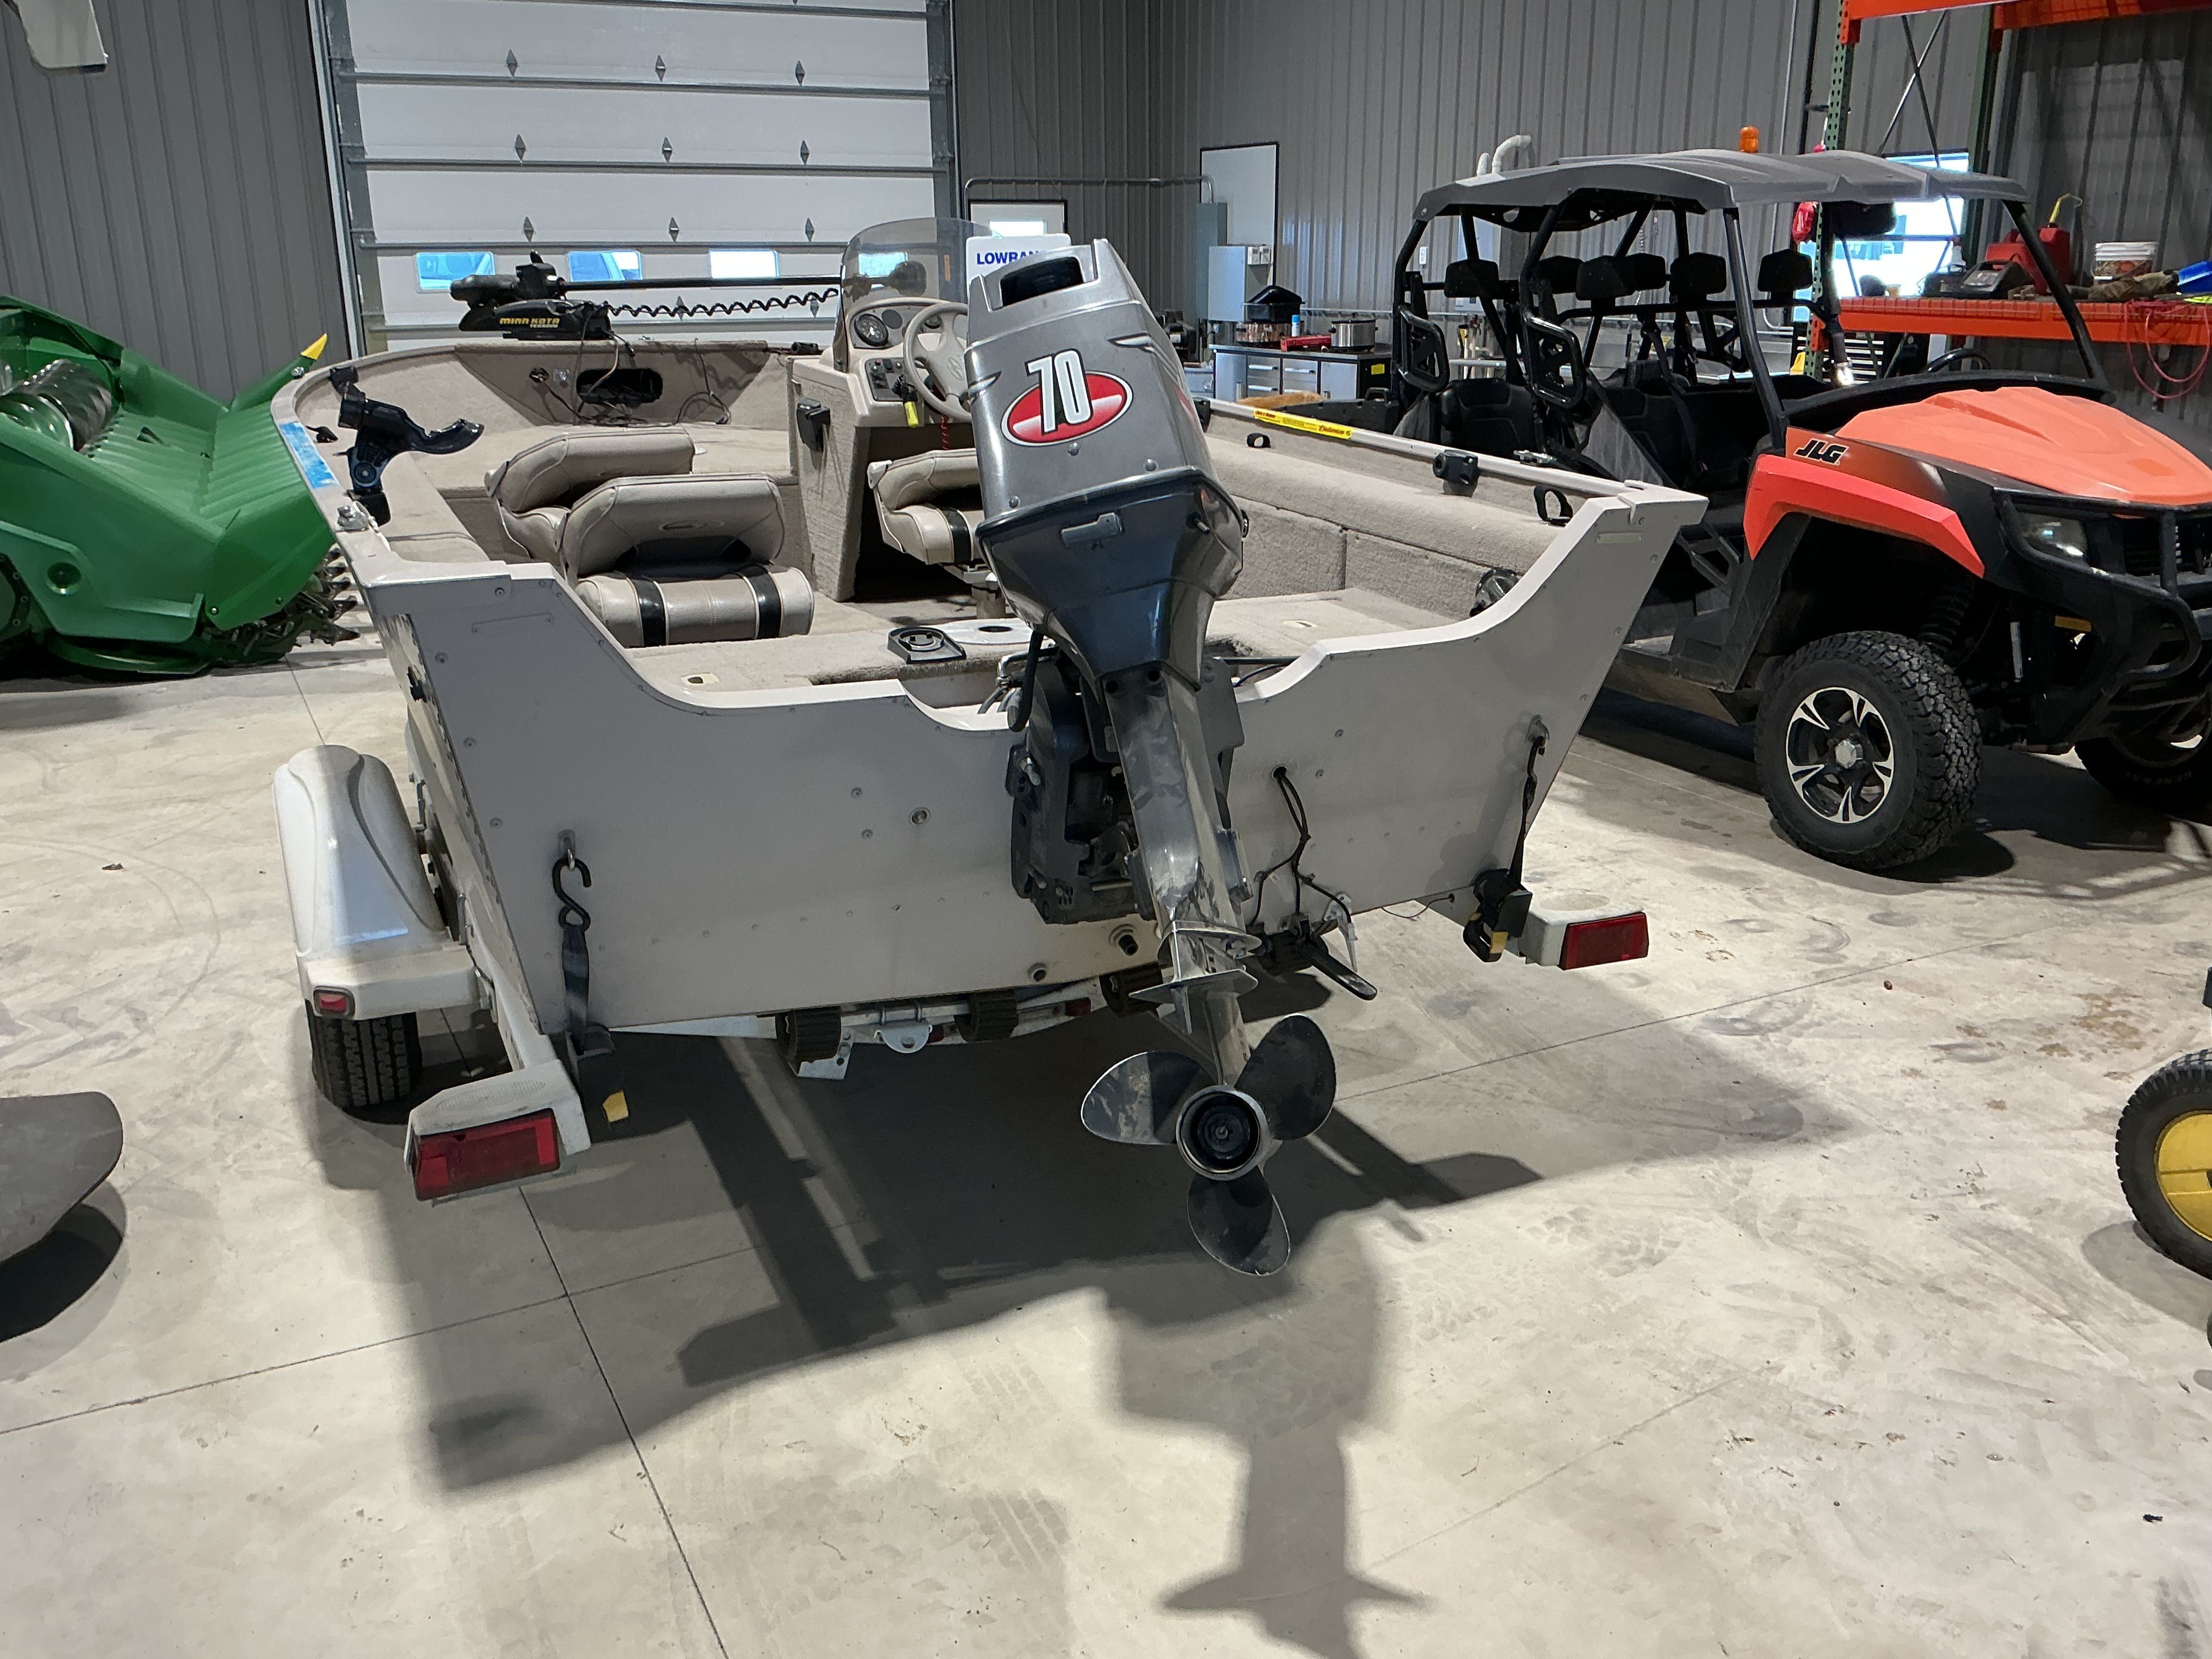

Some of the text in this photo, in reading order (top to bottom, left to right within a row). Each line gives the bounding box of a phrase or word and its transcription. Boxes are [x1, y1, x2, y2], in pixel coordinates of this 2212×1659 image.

[977, 251, 1039, 264] LOWRA
[1025, 348, 1093, 435] 70
[1793, 438, 1848, 464] JLG
